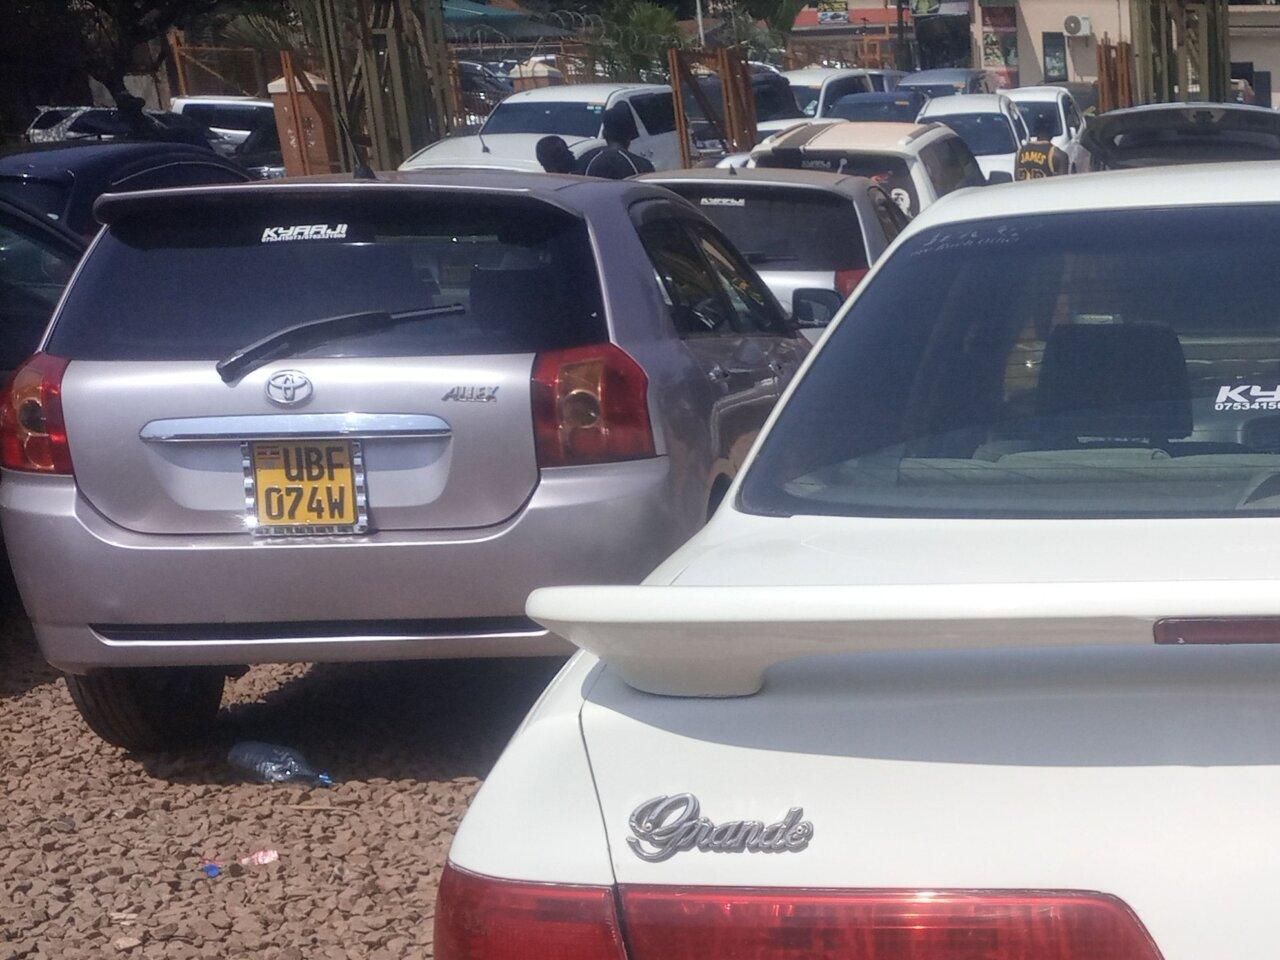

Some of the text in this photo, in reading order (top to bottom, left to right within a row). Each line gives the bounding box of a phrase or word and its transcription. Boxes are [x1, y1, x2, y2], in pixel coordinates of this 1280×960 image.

[1021, 151, 1046, 165] JAMES
[262, 223, 348, 240] KYAAJI
[441, 385, 499, 402] ALLEX
[283, 446, 344, 481] UBF
[265, 486, 345, 520] 074W
[626, 792, 814, 863] Grande
